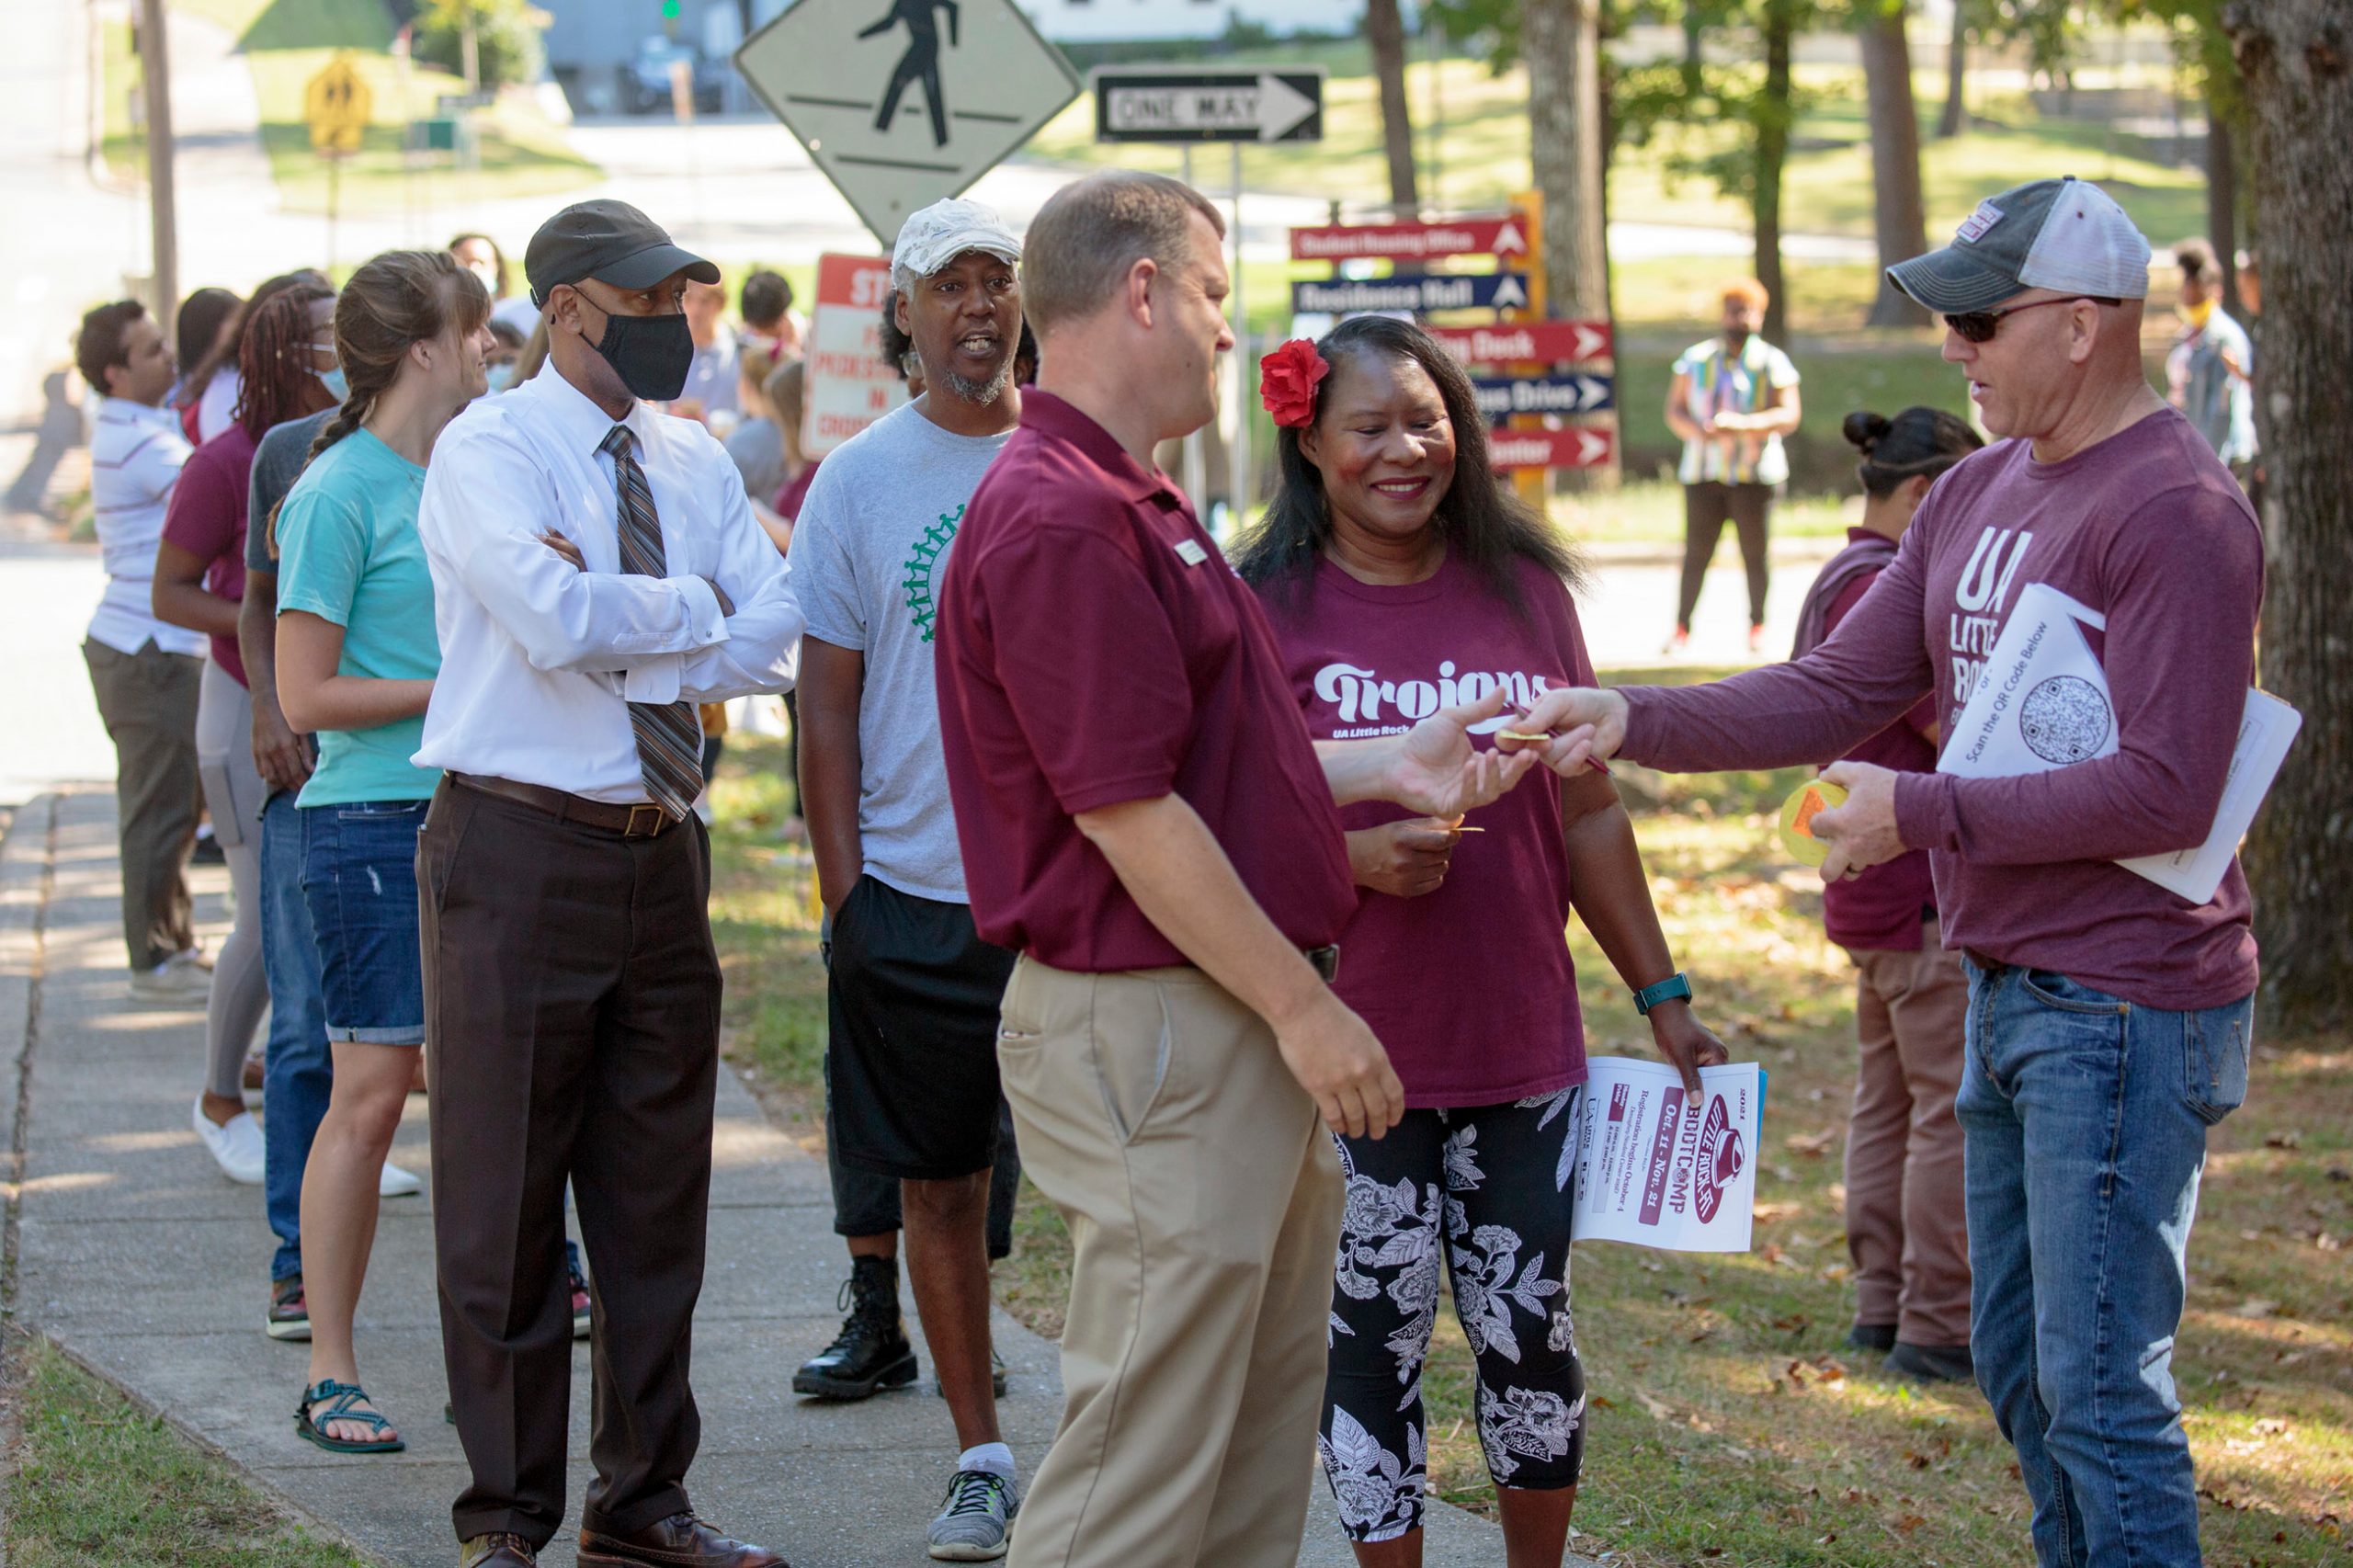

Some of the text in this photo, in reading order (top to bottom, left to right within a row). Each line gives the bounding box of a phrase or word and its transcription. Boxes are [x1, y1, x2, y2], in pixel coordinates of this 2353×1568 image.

[1118, 93, 1180, 125] ONE
[1300, 230, 1475, 256] Student Housing Office
[850, 267, 892, 306] ST
[1300, 278, 1474, 312] Residence Hall
[1512, 380, 1577, 411] Drive
[1489, 437, 1553, 466] enter
[1955, 526, 2033, 613] UA
[1966, 621, 2049, 764] Scan the QR Code Below
[1981, 674, 1992, 690] or
[1333, 724, 1410, 739] UA Little Rock
[1631, 1090, 1649, 1142] Registration
[1662, 1104, 1677, 1131] Oct.
[1701, 1100, 1722, 1150] LITTLE
[1626, 1142, 1639, 1170] begins
[1651, 1157, 1666, 1188] Nov.
[1620, 1171, 1632, 1206] October
[1647, 1191, 1658, 1207] 21
